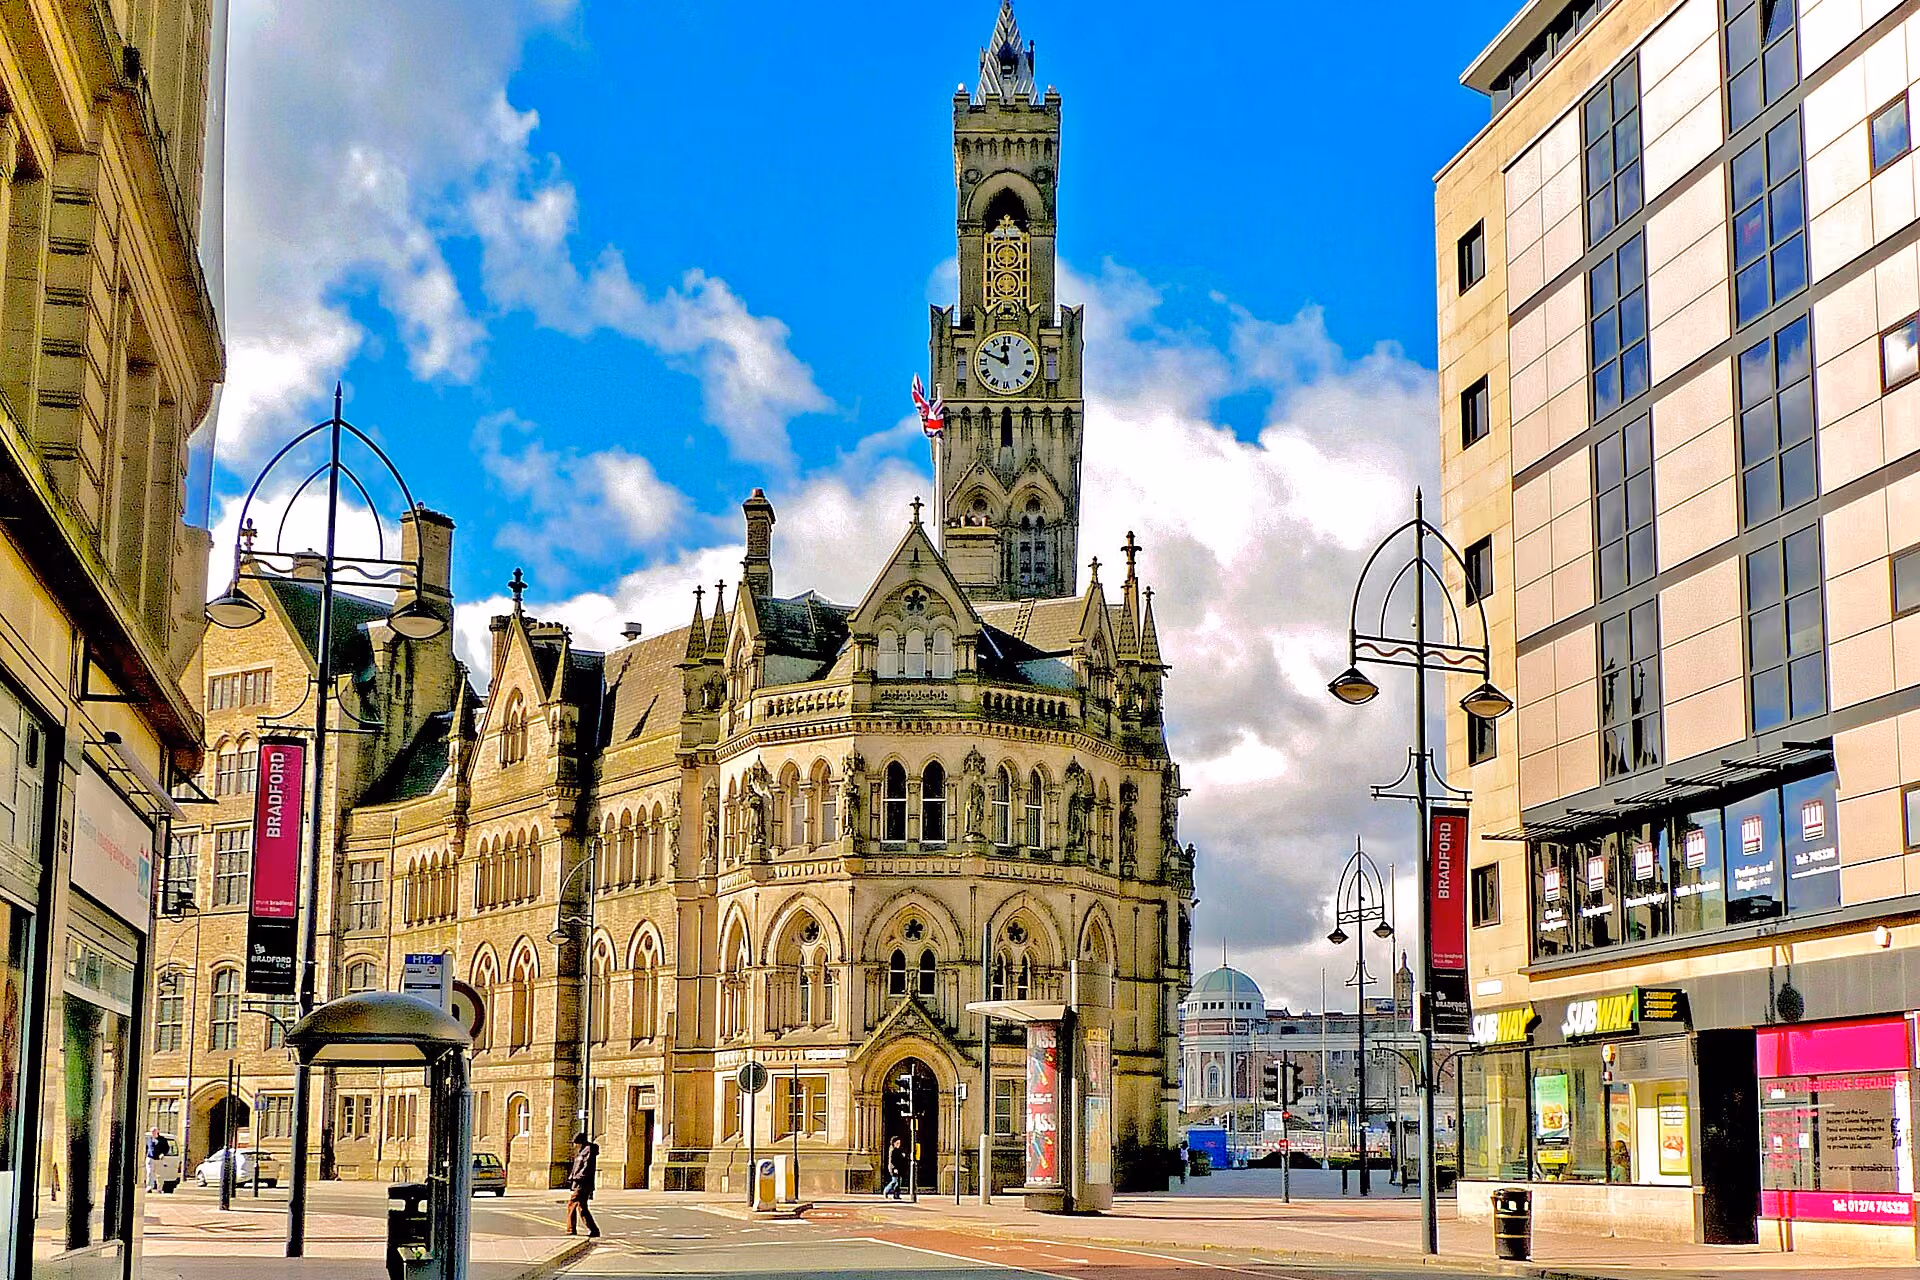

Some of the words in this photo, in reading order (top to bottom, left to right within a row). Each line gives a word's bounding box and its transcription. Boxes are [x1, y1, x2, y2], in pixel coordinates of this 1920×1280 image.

[266, 752, 285, 838] BRADFORD
[1438, 822, 1452, 899] BRADFORD
[251, 955, 292, 963] BRADFORD
[412, 955, 434, 964] H12
[1643, 991, 1677, 1000] SUBWAY
[1643, 1001, 1677, 1009] SUBWAY
[1561, 993, 1634, 1040] SUBWAY
[1644, 1010, 1678, 1018] SUBWAY
[1468, 1001, 1536, 1047] SUBWAY
[1847, 1199, 1876, 1213] 01274
